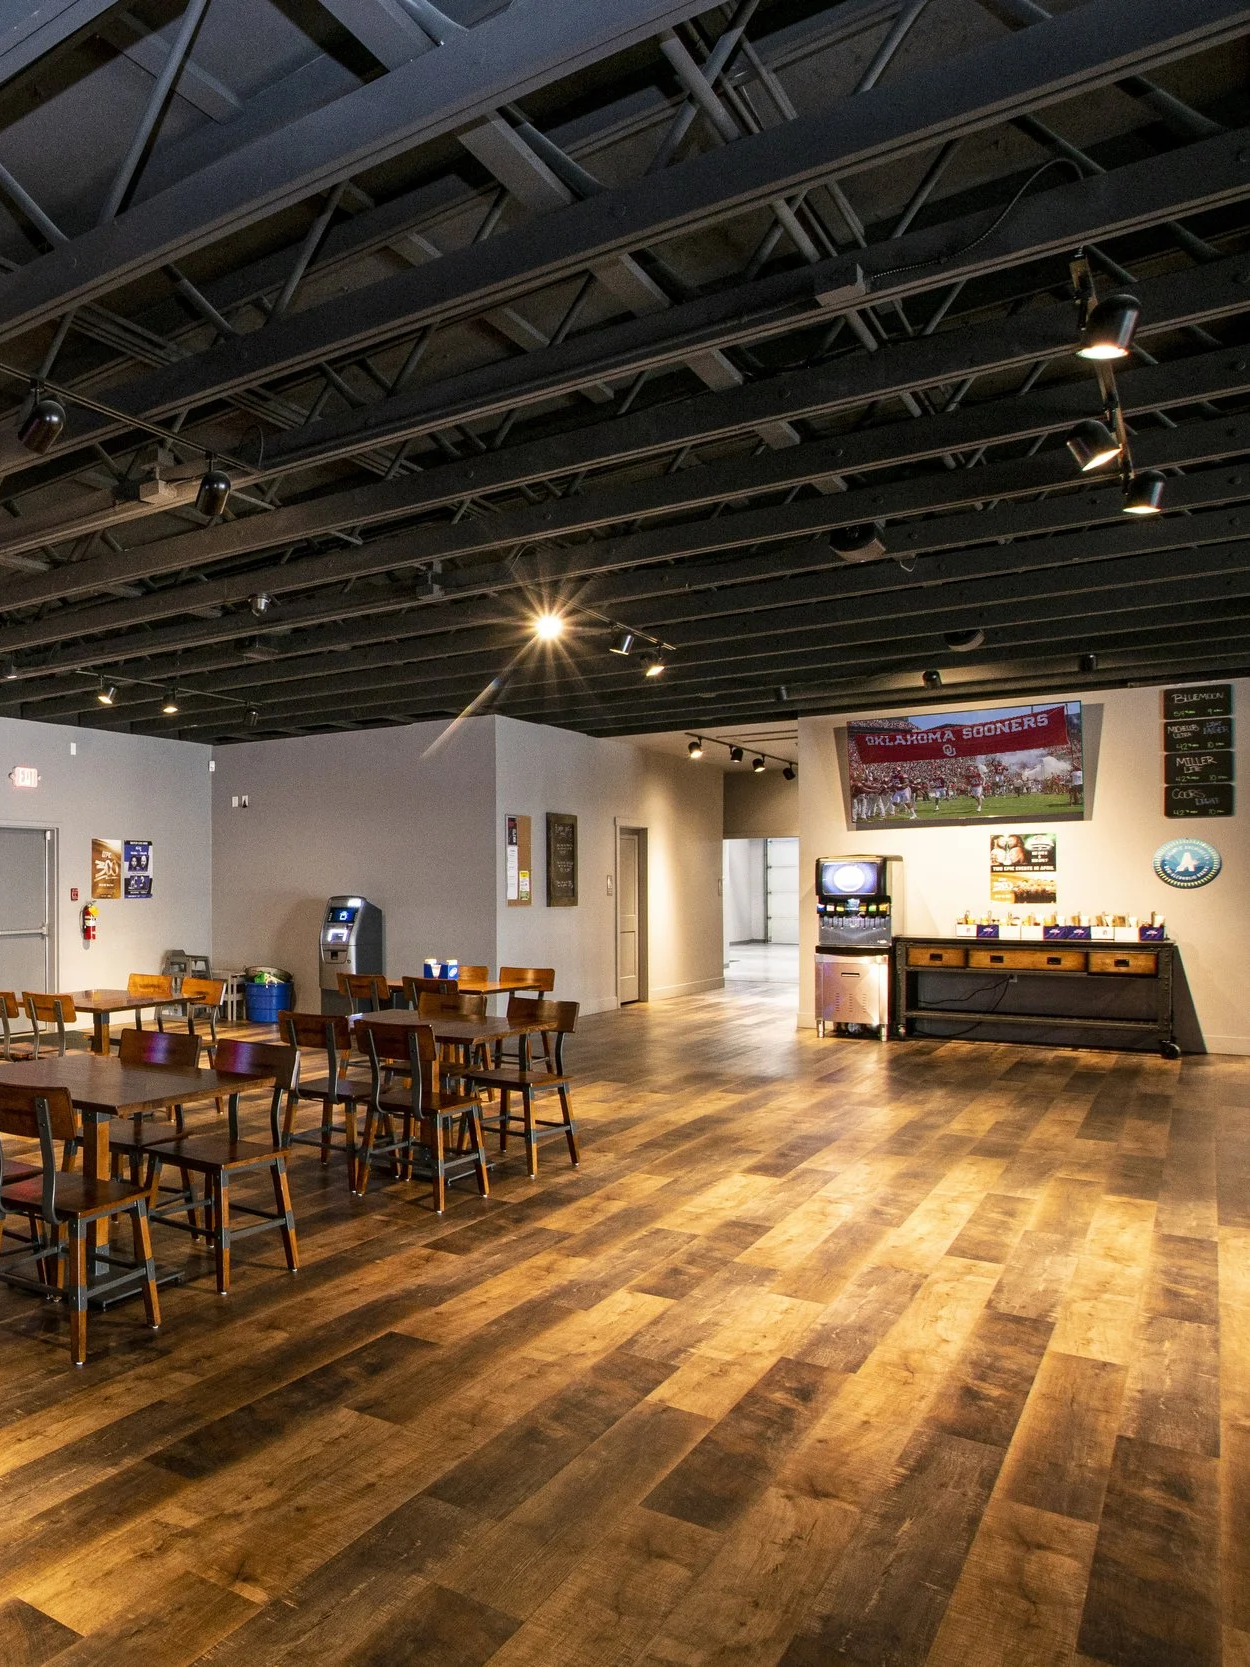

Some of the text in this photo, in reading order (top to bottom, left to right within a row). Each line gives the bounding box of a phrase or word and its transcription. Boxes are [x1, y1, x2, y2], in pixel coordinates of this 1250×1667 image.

[866, 713, 1049, 747] OKLAHOMA SOONERS
[1176, 755, 1218, 767] MILLER
